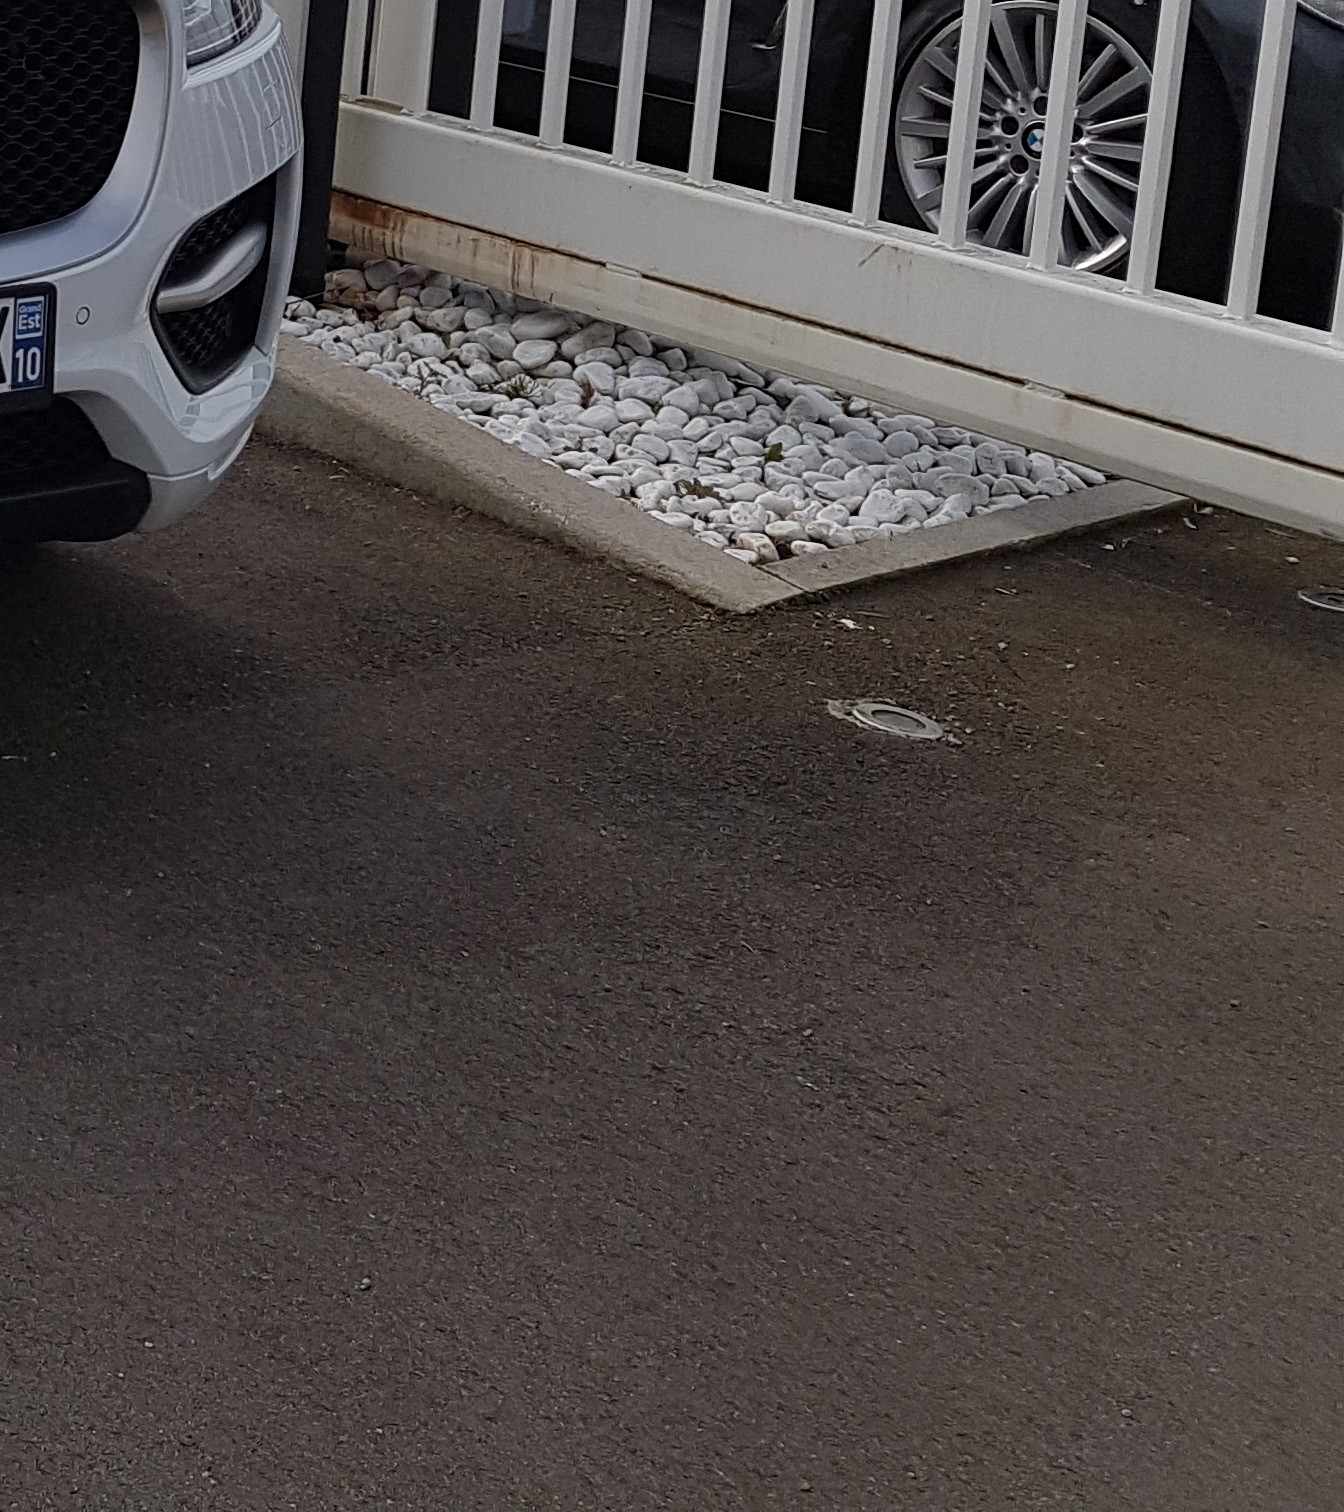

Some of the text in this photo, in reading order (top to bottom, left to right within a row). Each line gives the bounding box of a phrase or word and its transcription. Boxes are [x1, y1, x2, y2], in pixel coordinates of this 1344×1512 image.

[19, 303, 42, 314] Grand
[18, 313, 41, 330] Est
[15, 347, 41, 383] 10
